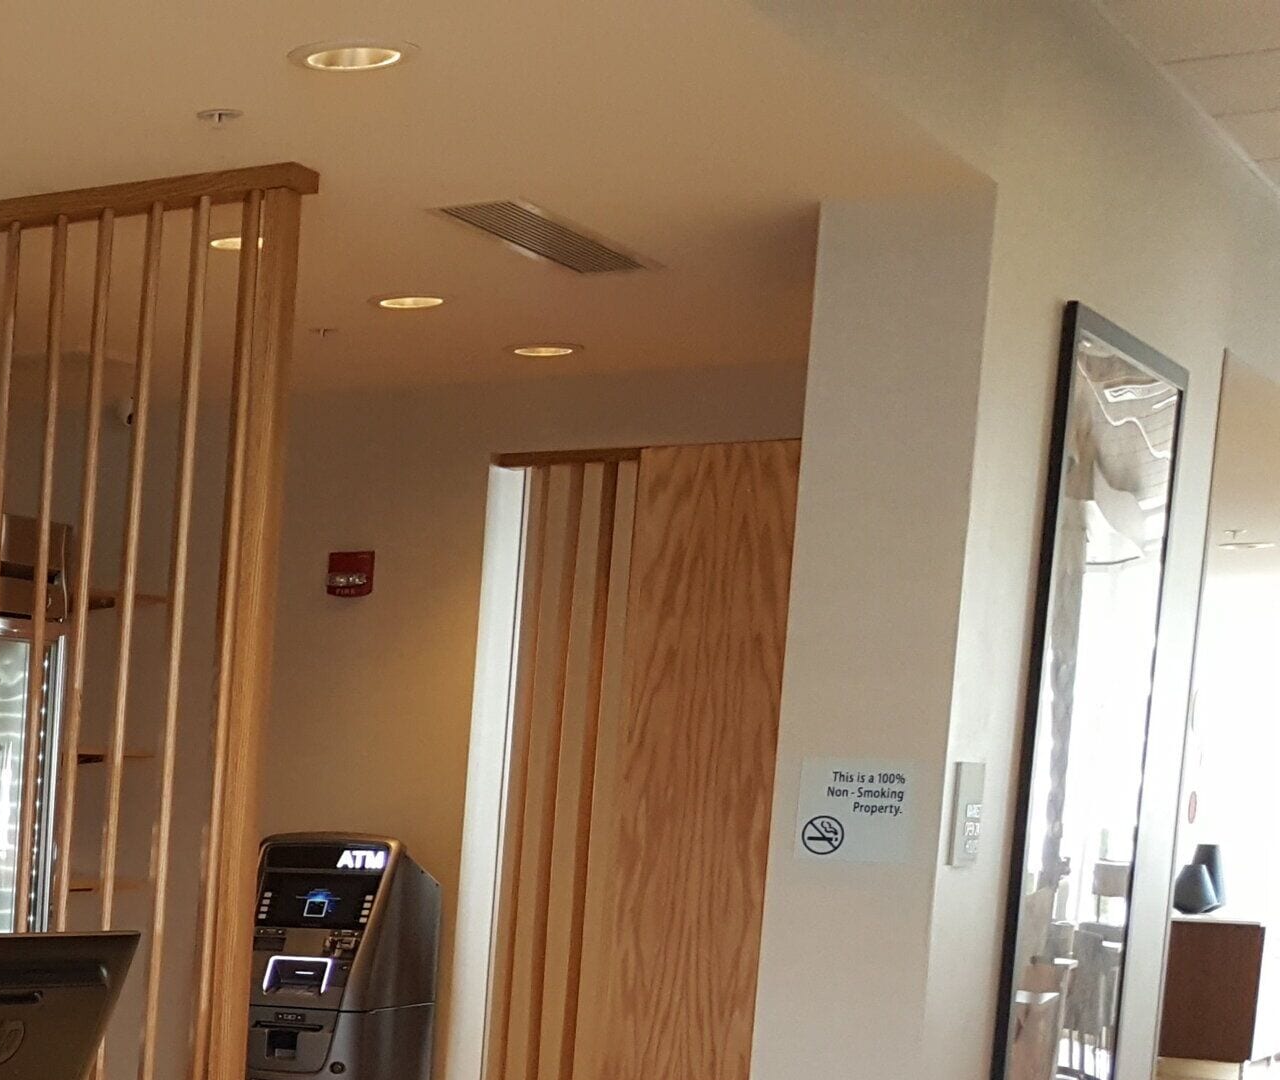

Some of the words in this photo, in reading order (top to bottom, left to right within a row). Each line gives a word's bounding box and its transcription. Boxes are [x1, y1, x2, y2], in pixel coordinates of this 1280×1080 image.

[832, 771, 854, 783] This
[856, 771, 865, 783] is
[867, 775, 874, 784] a
[877, 773, 906, 784] 100%
[827, 786, 849, 797] Non
[856, 787, 904, 802] Smoking
[852, 802, 903, 816] Property.
[336, 850, 385, 869] ATM
